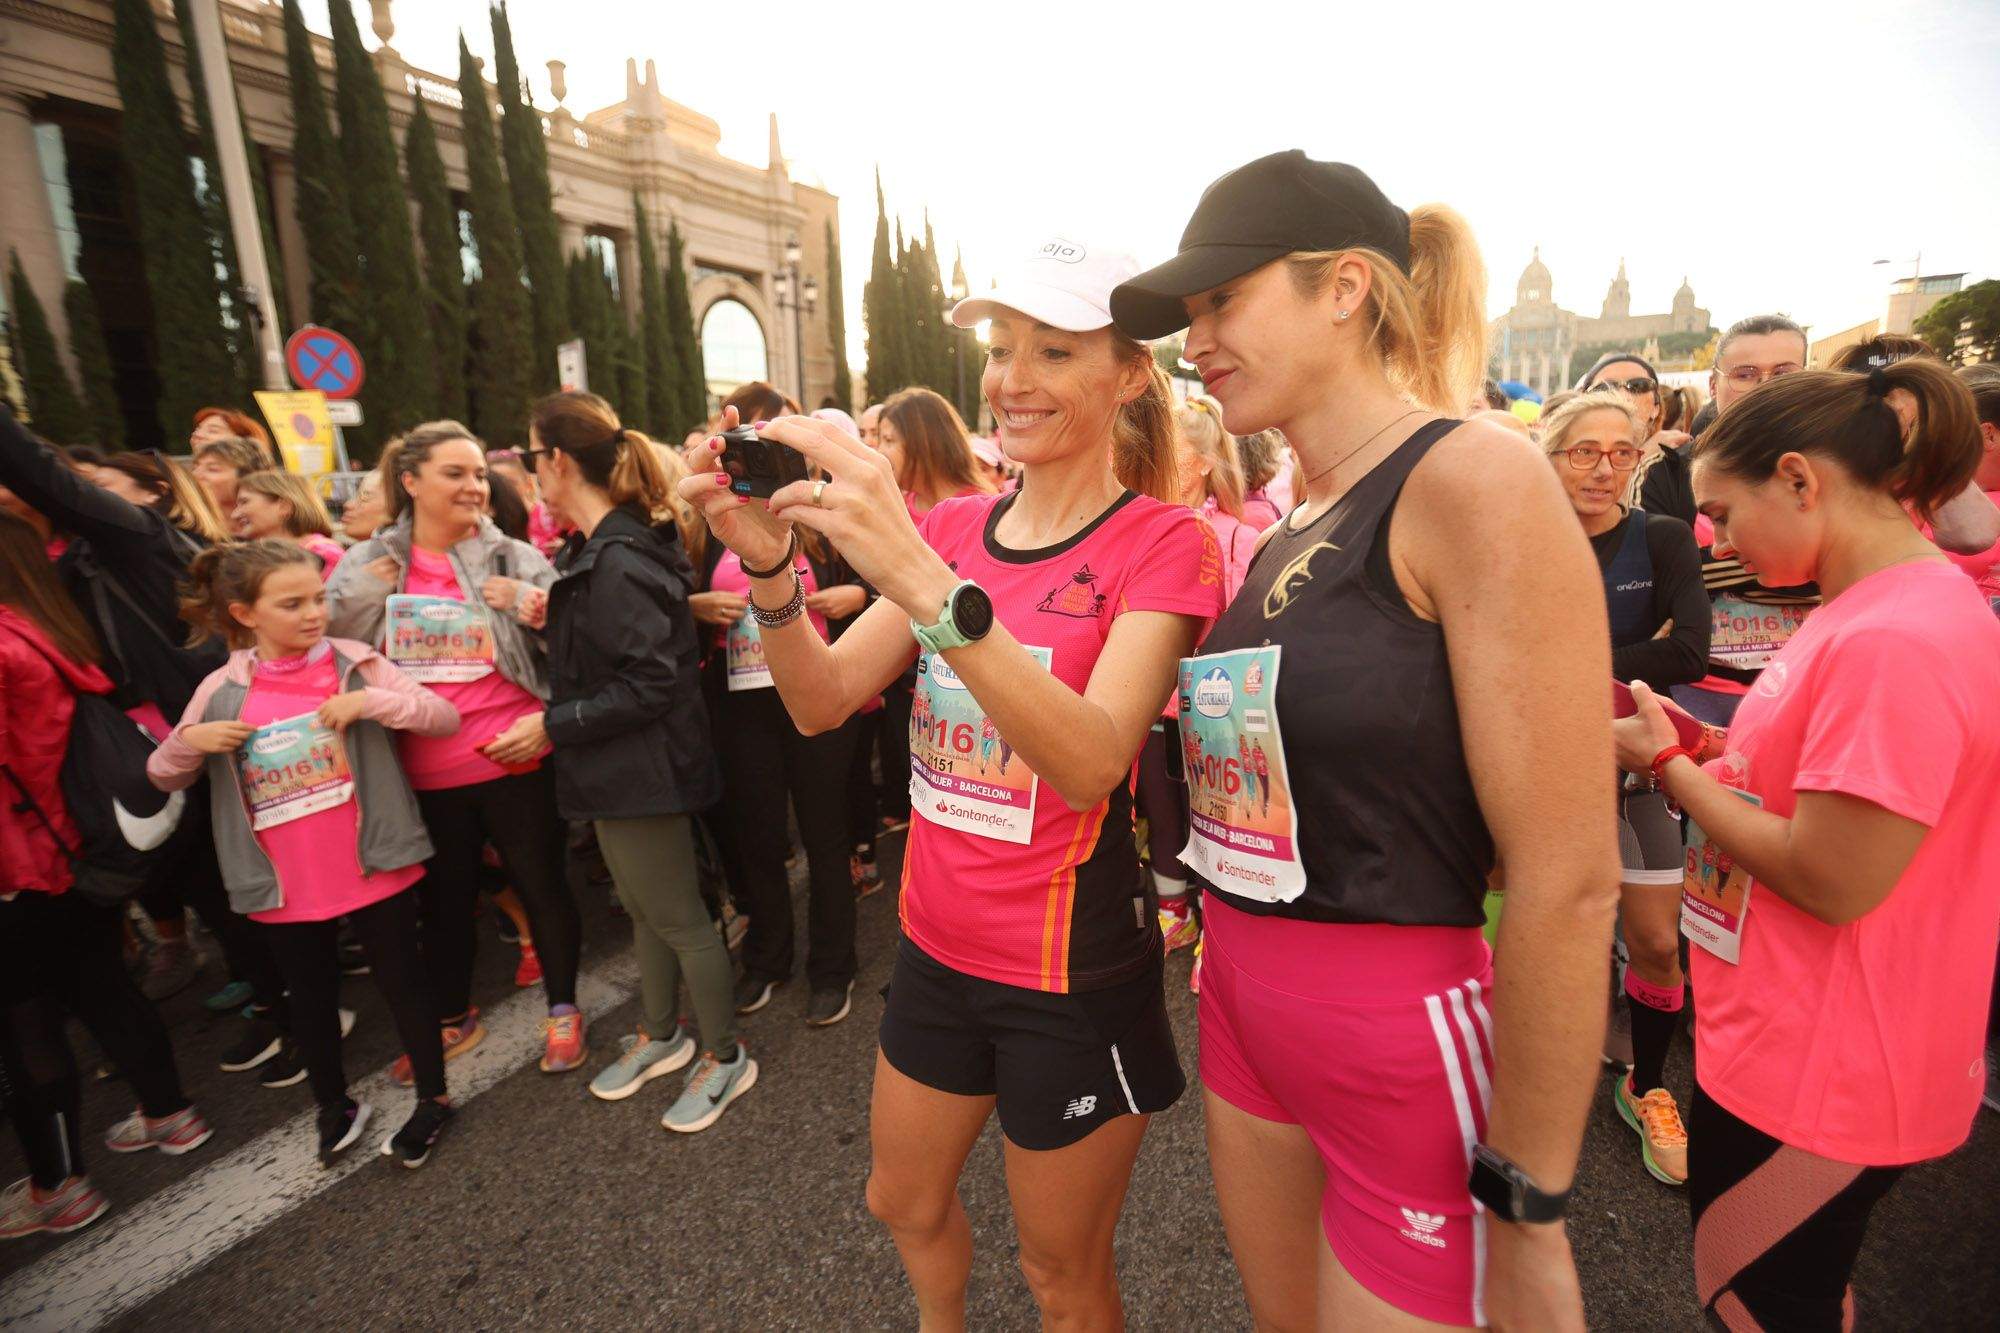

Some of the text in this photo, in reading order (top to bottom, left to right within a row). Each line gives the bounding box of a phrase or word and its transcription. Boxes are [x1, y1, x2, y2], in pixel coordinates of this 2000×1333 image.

[1732, 615, 1780, 632] 016
[928, 714, 975, 754] 016
[267, 760, 313, 785] 016
[1204, 753, 1242, 796] 016
[931, 773, 953, 788] MUJER
[960, 780, 1013, 802] BARCELONA
[949, 804, 1008, 828] Santander
[1228, 831, 1276, 852] BARCELONA
[1224, 861, 1276, 886] Santander
[1688, 896, 1726, 923] BARCELONA
[1400, 1229, 1446, 1249] adidas
